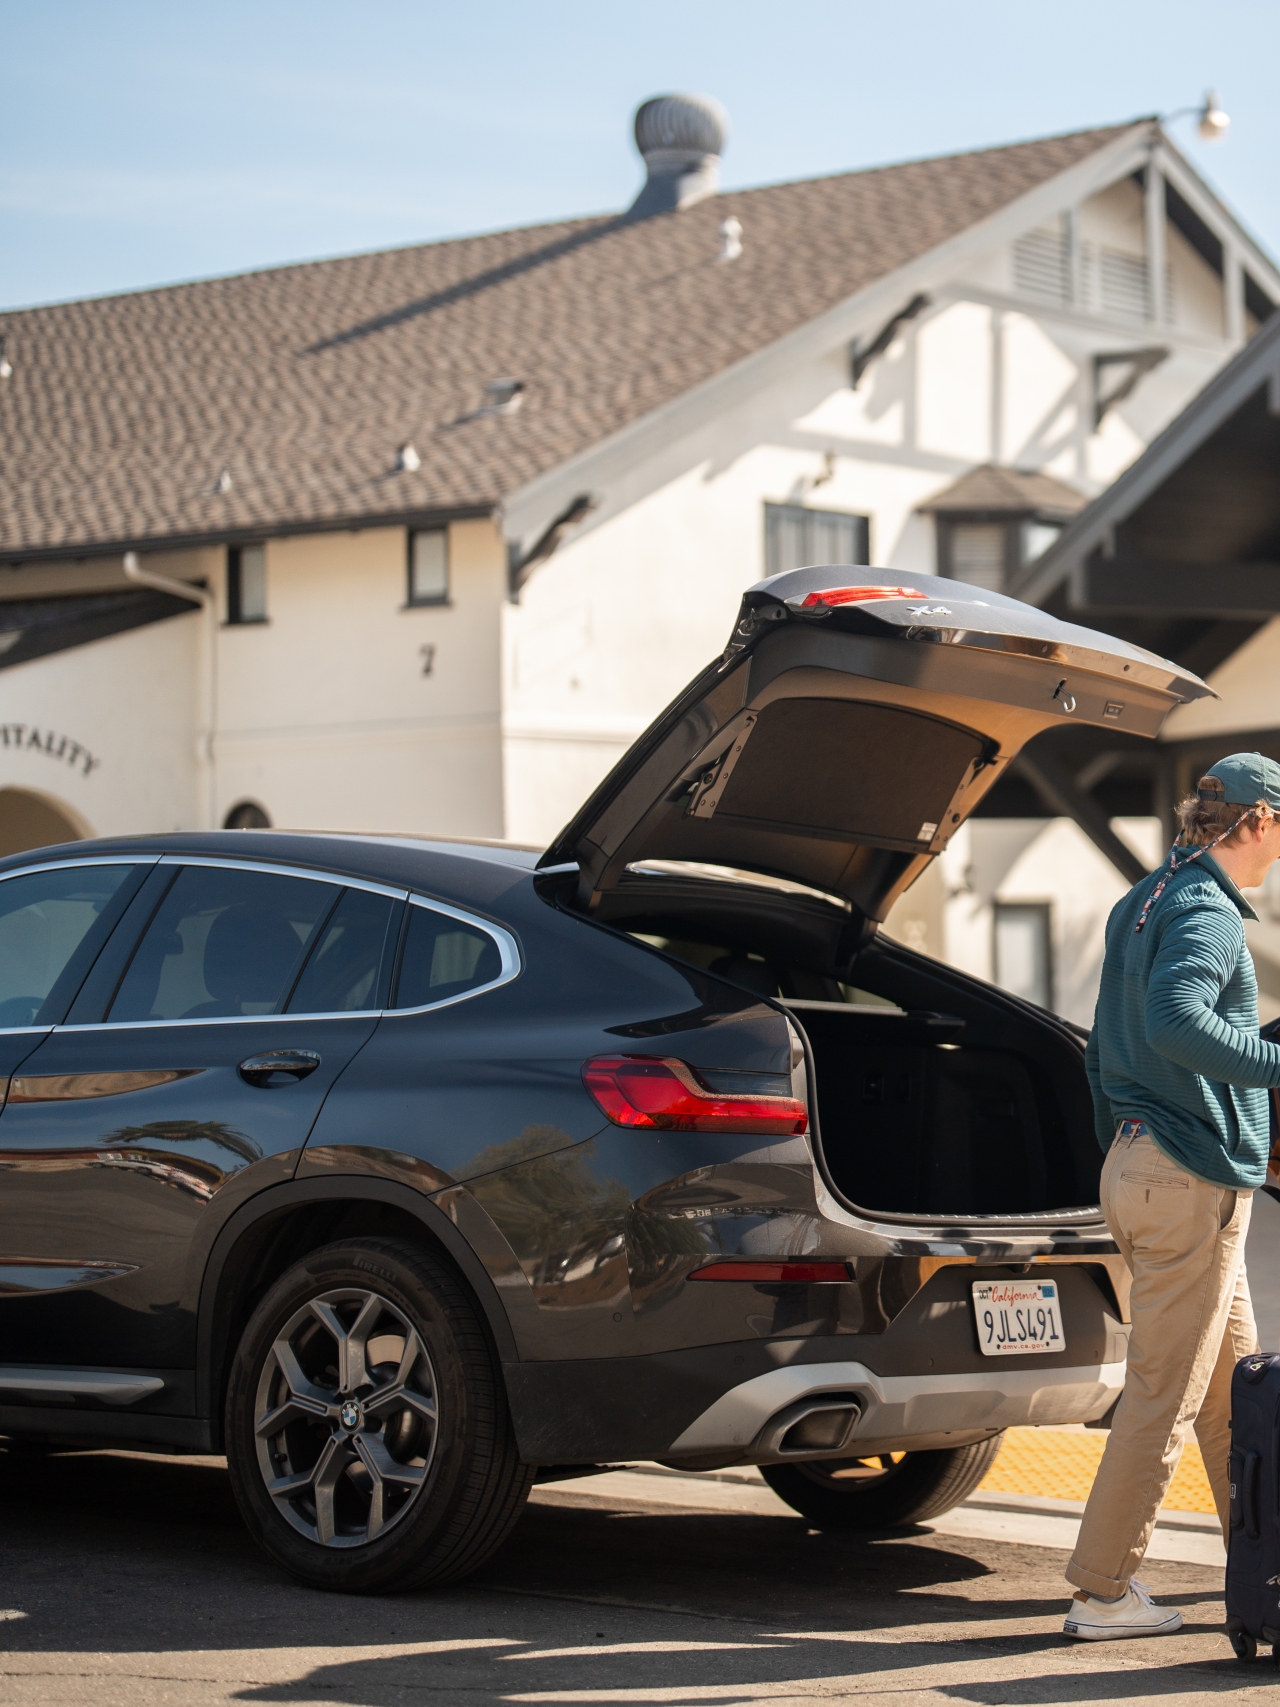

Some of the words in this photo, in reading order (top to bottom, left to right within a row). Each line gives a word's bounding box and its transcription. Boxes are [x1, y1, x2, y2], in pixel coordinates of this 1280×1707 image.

[418, 643, 436, 679] 7
[0, 723, 100, 776] ITALITY
[353, 1254, 396, 1281] PIRELLI
[992, 1286, 1043, 1307] California
[984, 1308, 1059, 1343] 9JLS491
